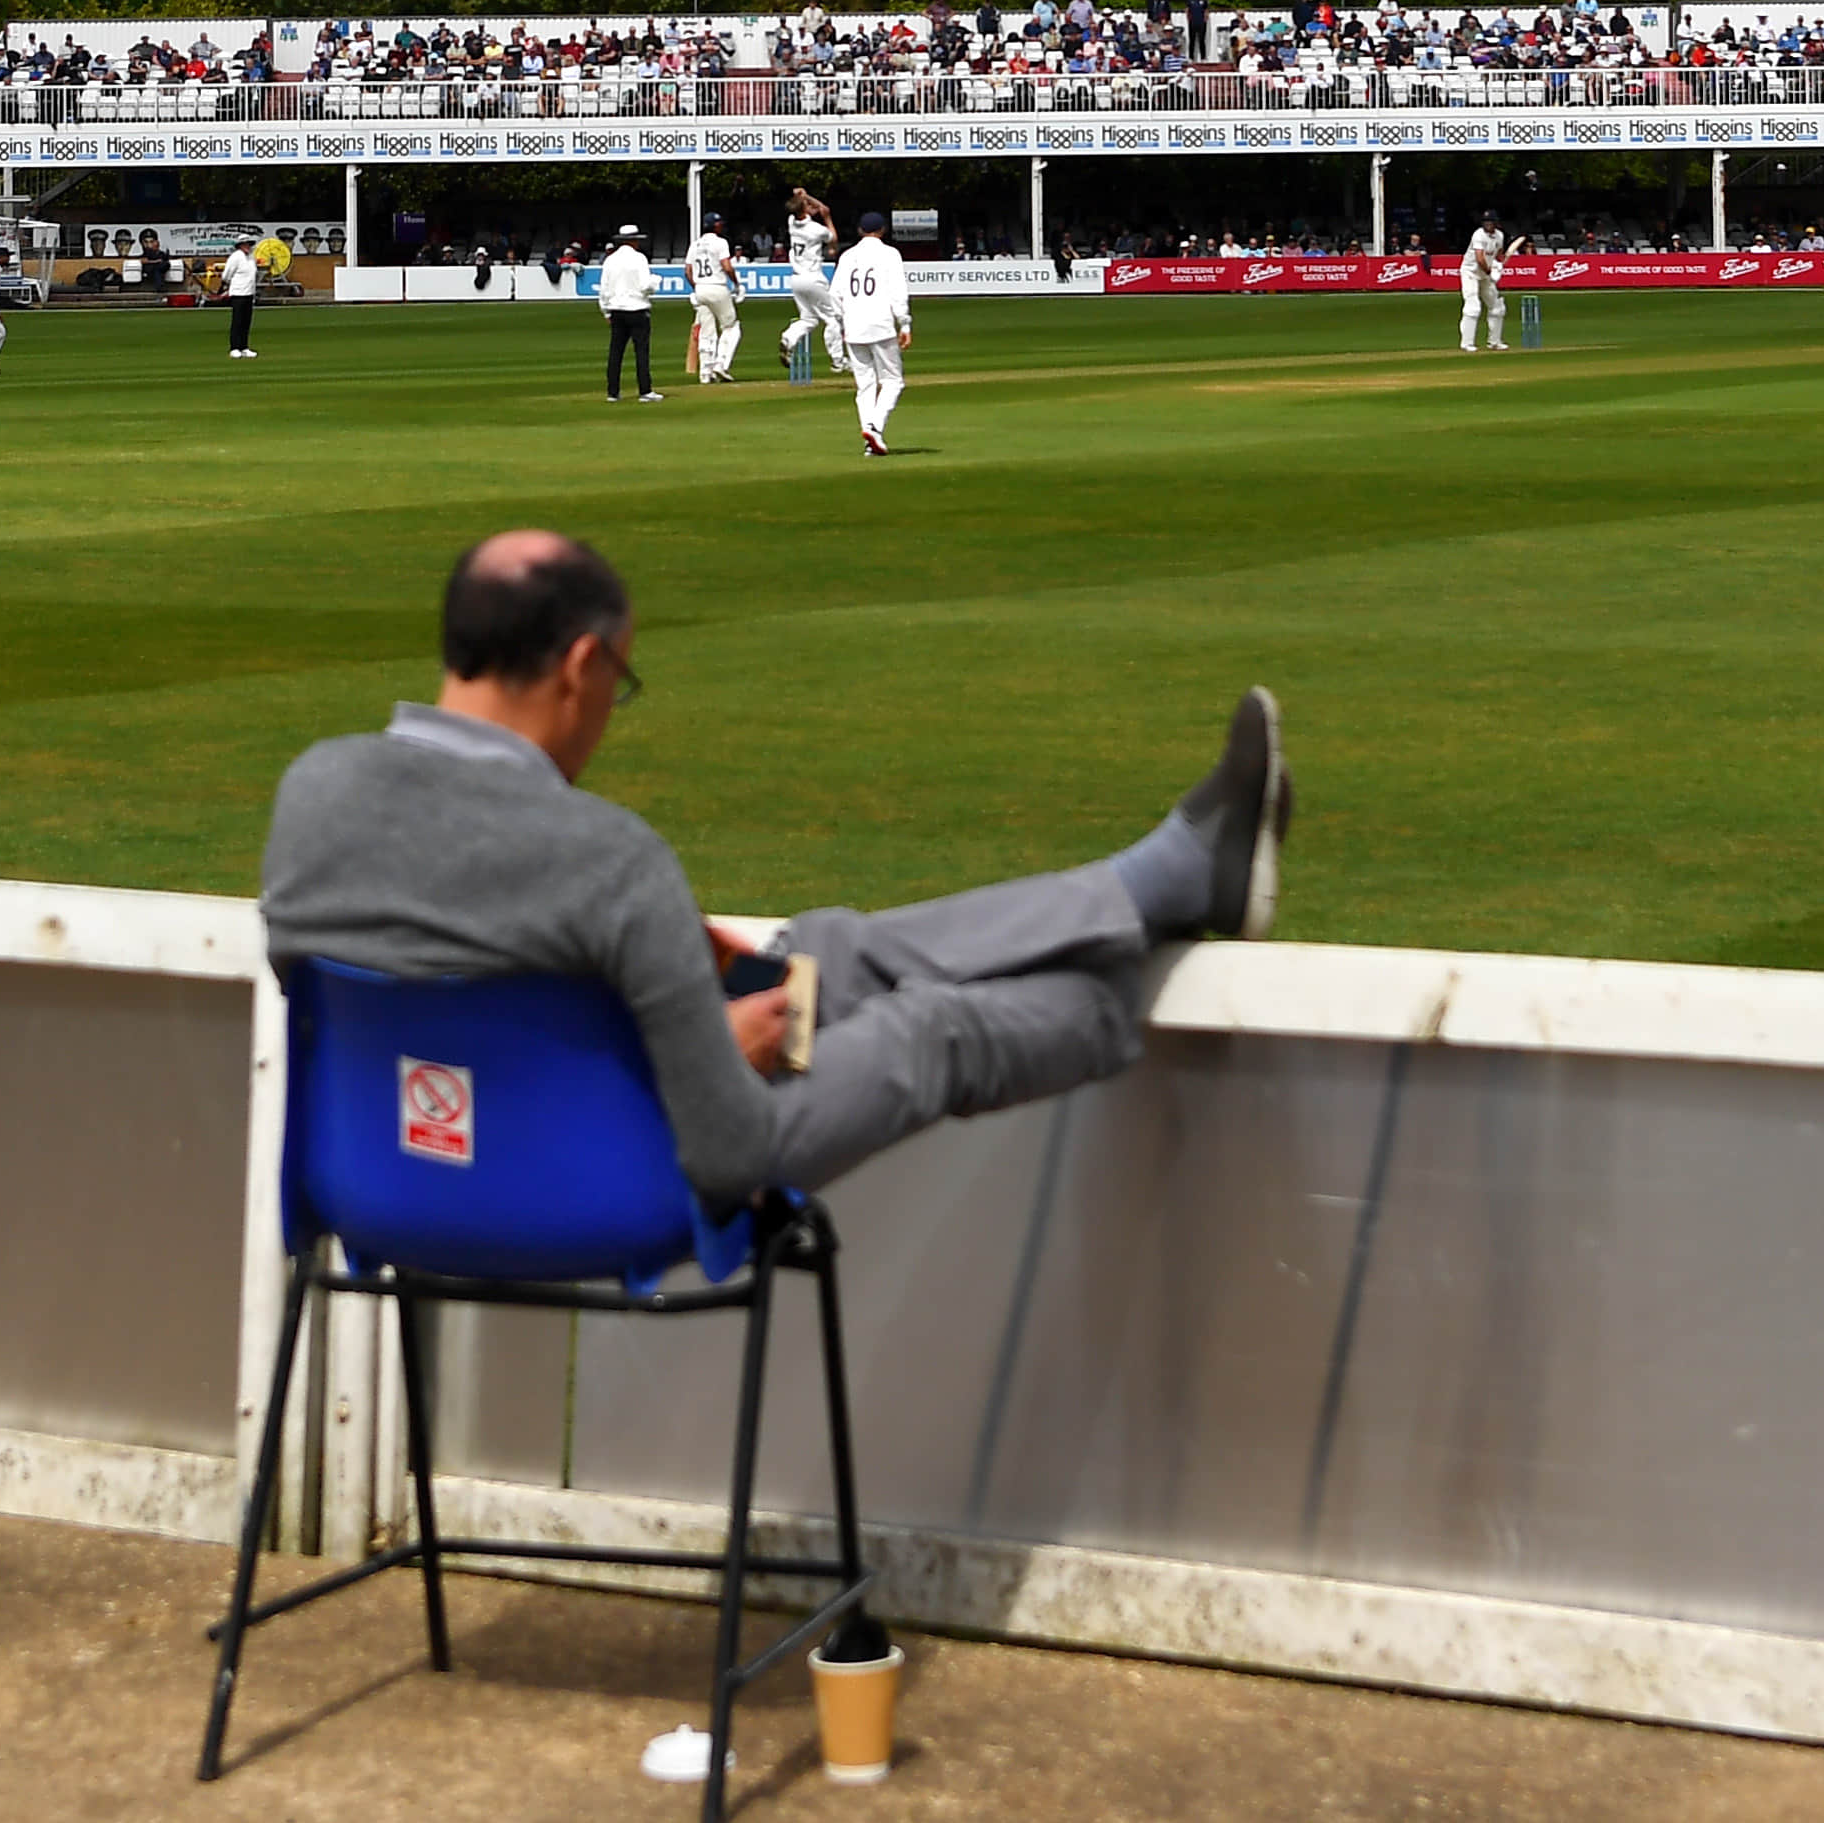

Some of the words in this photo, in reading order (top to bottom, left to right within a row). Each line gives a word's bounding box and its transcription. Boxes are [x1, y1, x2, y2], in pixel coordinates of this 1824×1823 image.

[705, 129, 763, 153] Higgins
[772, 129, 830, 152] Higgins
[837, 128, 895, 151] Higgins
[903, 127, 961, 150] Higgins
[970, 127, 1028, 150] Higgins
[1036, 126, 1094, 149] Higgins
[1102, 125, 1160, 148] Higgins
[1168, 125, 1226, 147] Higgins
[1234, 124, 1292, 147] Higgins
[1300, 123, 1358, 146] Higgins
[1366, 123, 1424, 145] Higgins
[1432, 122, 1490, 145] Higgins
[1497, 121, 1555, 144] Higgins
[1563, 120, 1621, 143] Higgins
[1629, 120, 1687, 142] Higgins
[1695, 119, 1753, 142] Higgins
[1761, 118, 1819, 141] Higgins
[40, 136, 98, 160] Higgins
[107, 136, 165, 159] Higgins
[173, 135, 231, 158] Higgins
[240, 134, 298, 158] Higgins
[306, 134, 364, 157] Higgins
[374, 133, 432, 156] Higgins
[440, 132, 498, 155] Higgins
[507, 131, 565, 155] Higgins
[572, 131, 630, 154] Higgins
[639, 130, 697, 153] Higgins
[695, 258, 713, 278] 26
[958, 270, 1022, 282] SERVICES
[1025, 270, 1050, 281] LTD
[1302, 273, 1324, 281] GOOD
[1430, 268, 1444, 276] THE
[1515, 267, 1537, 275] TASTE
[1662, 265, 1684, 273] GOOD
[1686, 265, 1707, 273] TASTE
[850, 267, 876, 297] 66
